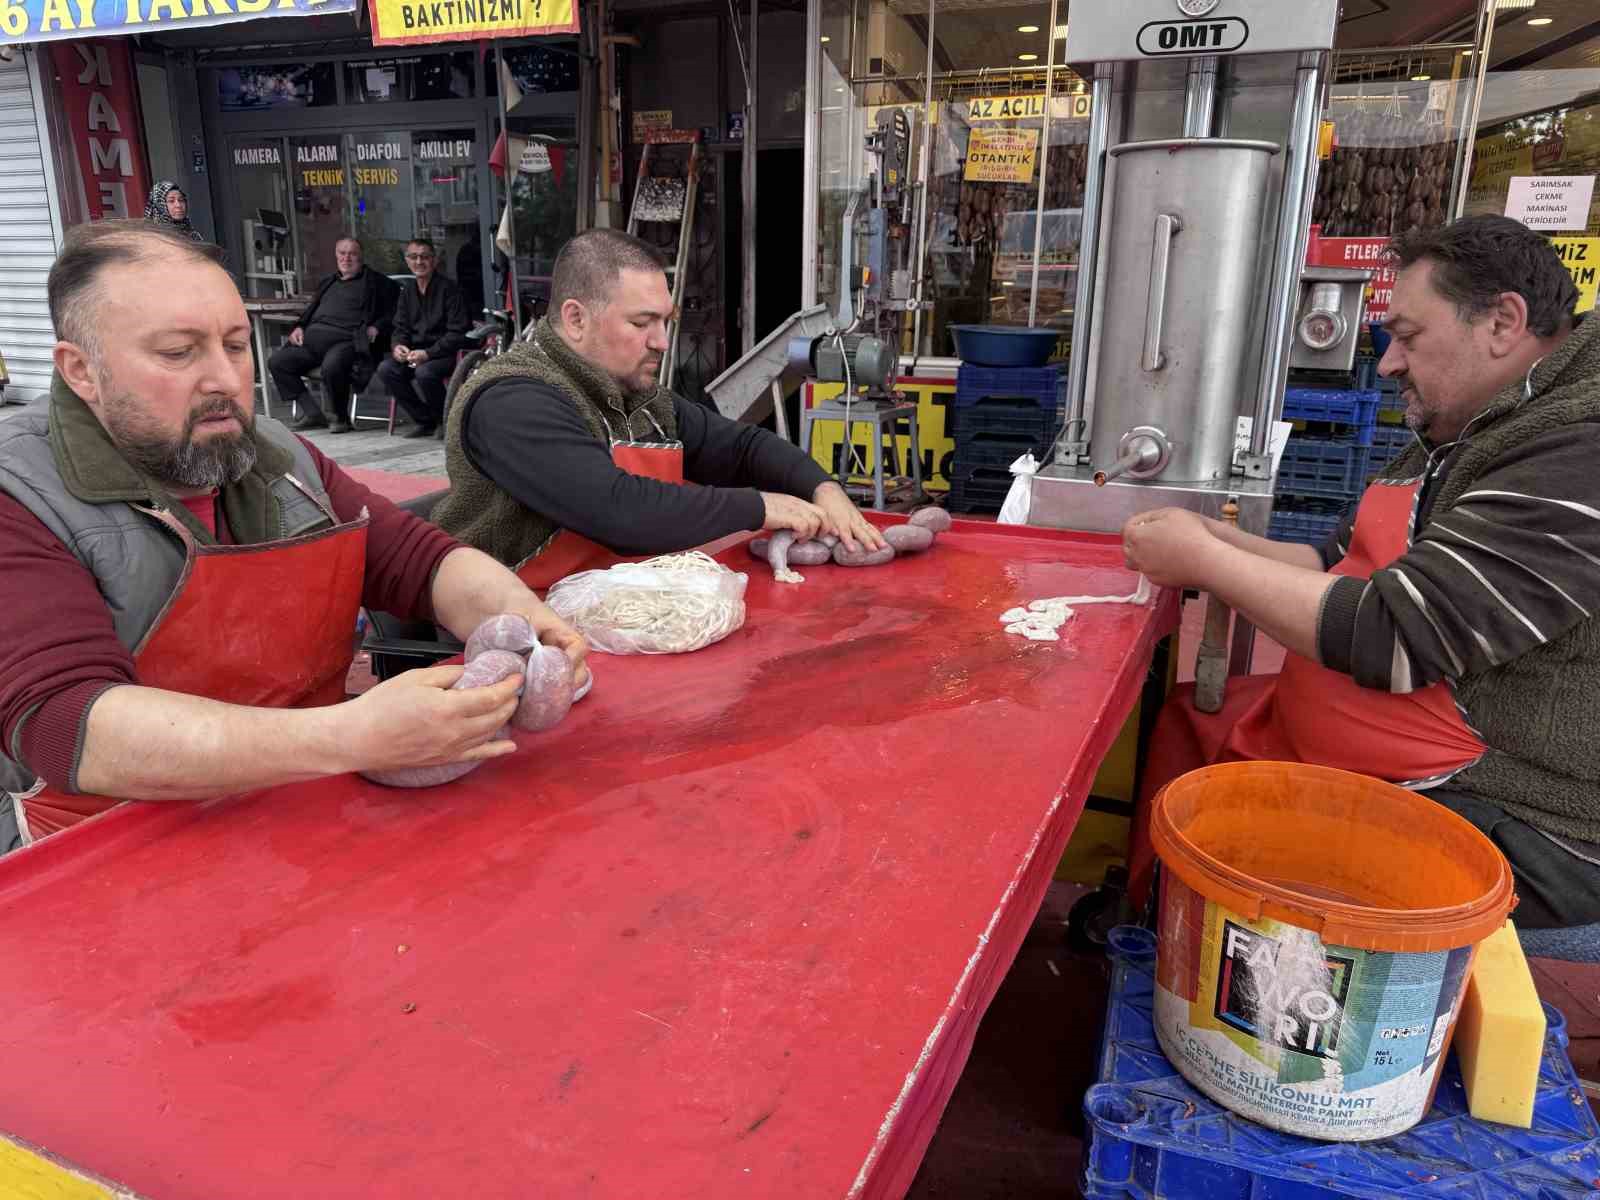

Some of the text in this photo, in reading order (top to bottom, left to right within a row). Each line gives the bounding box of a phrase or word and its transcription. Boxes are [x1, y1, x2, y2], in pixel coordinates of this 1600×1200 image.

[1158, 23, 1228, 49] OMT
[970, 99, 994, 118] AZ
[234, 147, 281, 165] KAMERA
[297, 145, 338, 163] ALARM
[420, 141, 453, 159] AKILLI
[456, 139, 471, 157] EV
[1259, 1092, 1315, 1115] INTERIOR
[1318, 1108, 1355, 1119] PAINT
[1338, 1097, 1376, 1110] MAT
